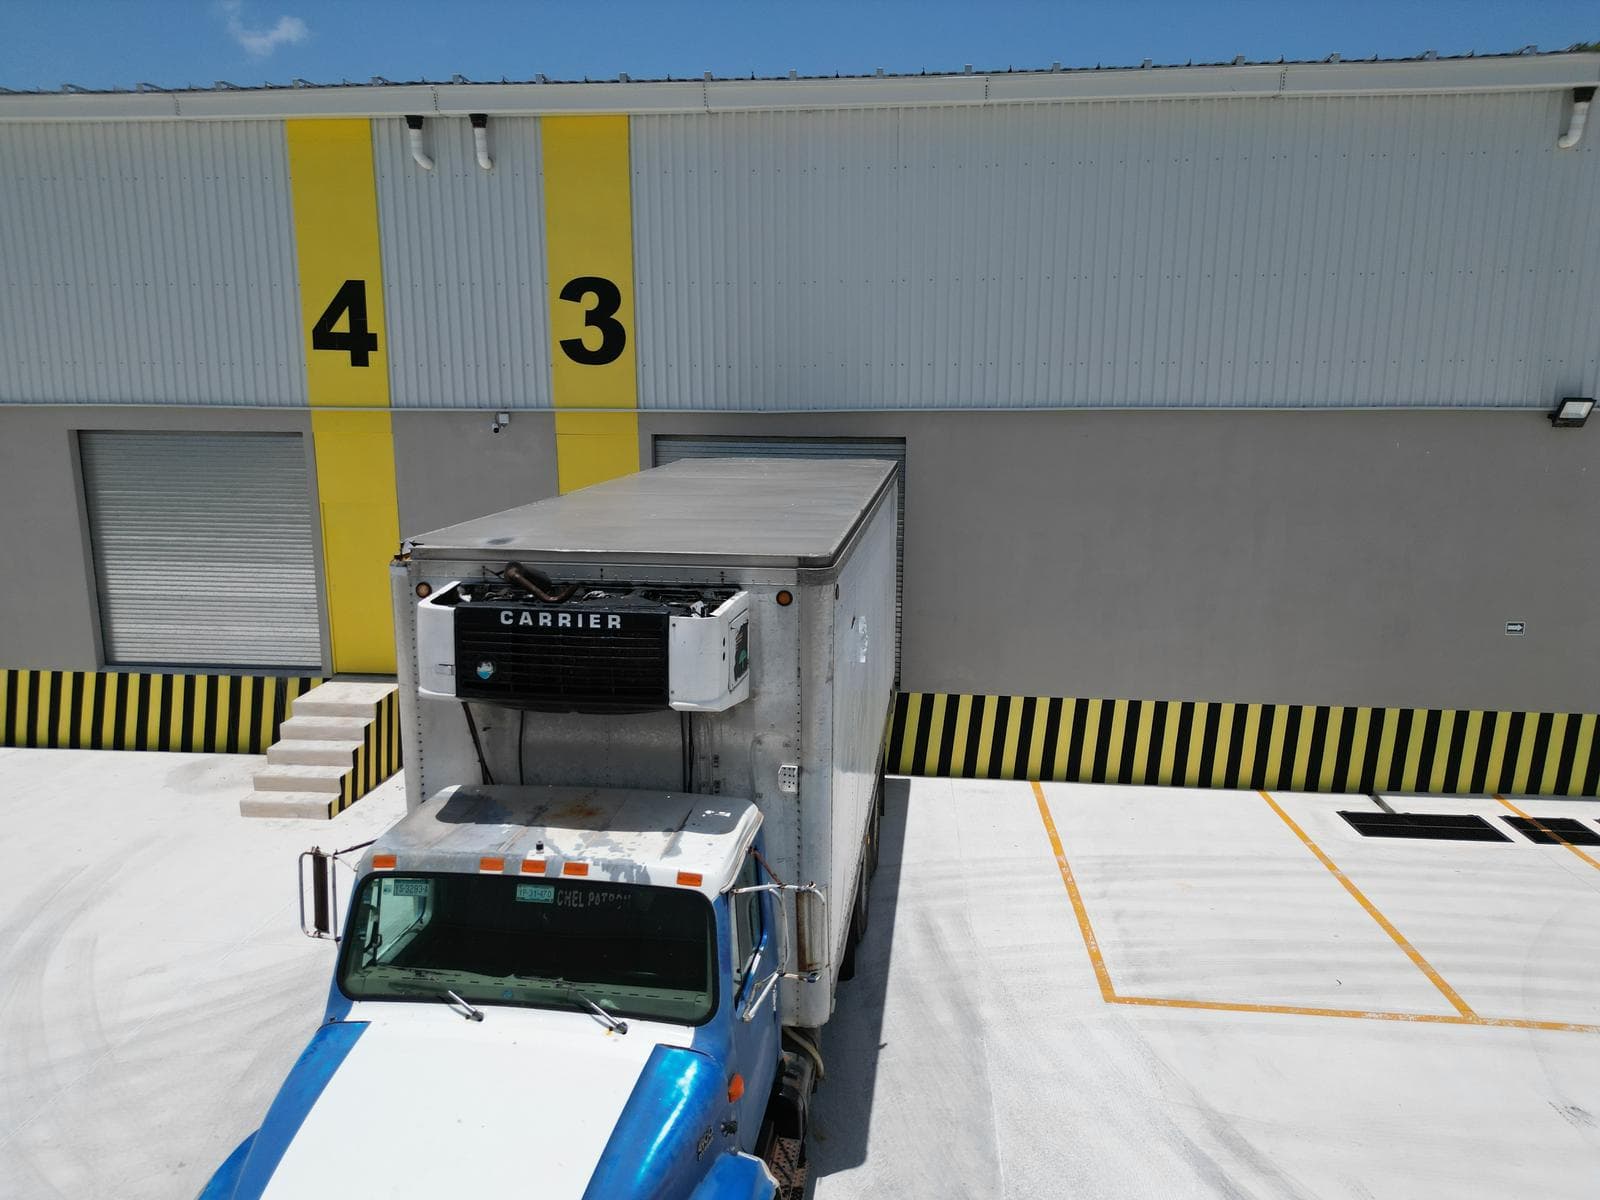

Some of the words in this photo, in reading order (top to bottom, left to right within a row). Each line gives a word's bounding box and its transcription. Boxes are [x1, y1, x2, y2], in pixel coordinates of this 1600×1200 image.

[312, 280, 378, 367] 4
[559, 276, 626, 365] 3
[500, 610, 621, 629] CARRIER
[557, 889, 584, 908] CHEL
